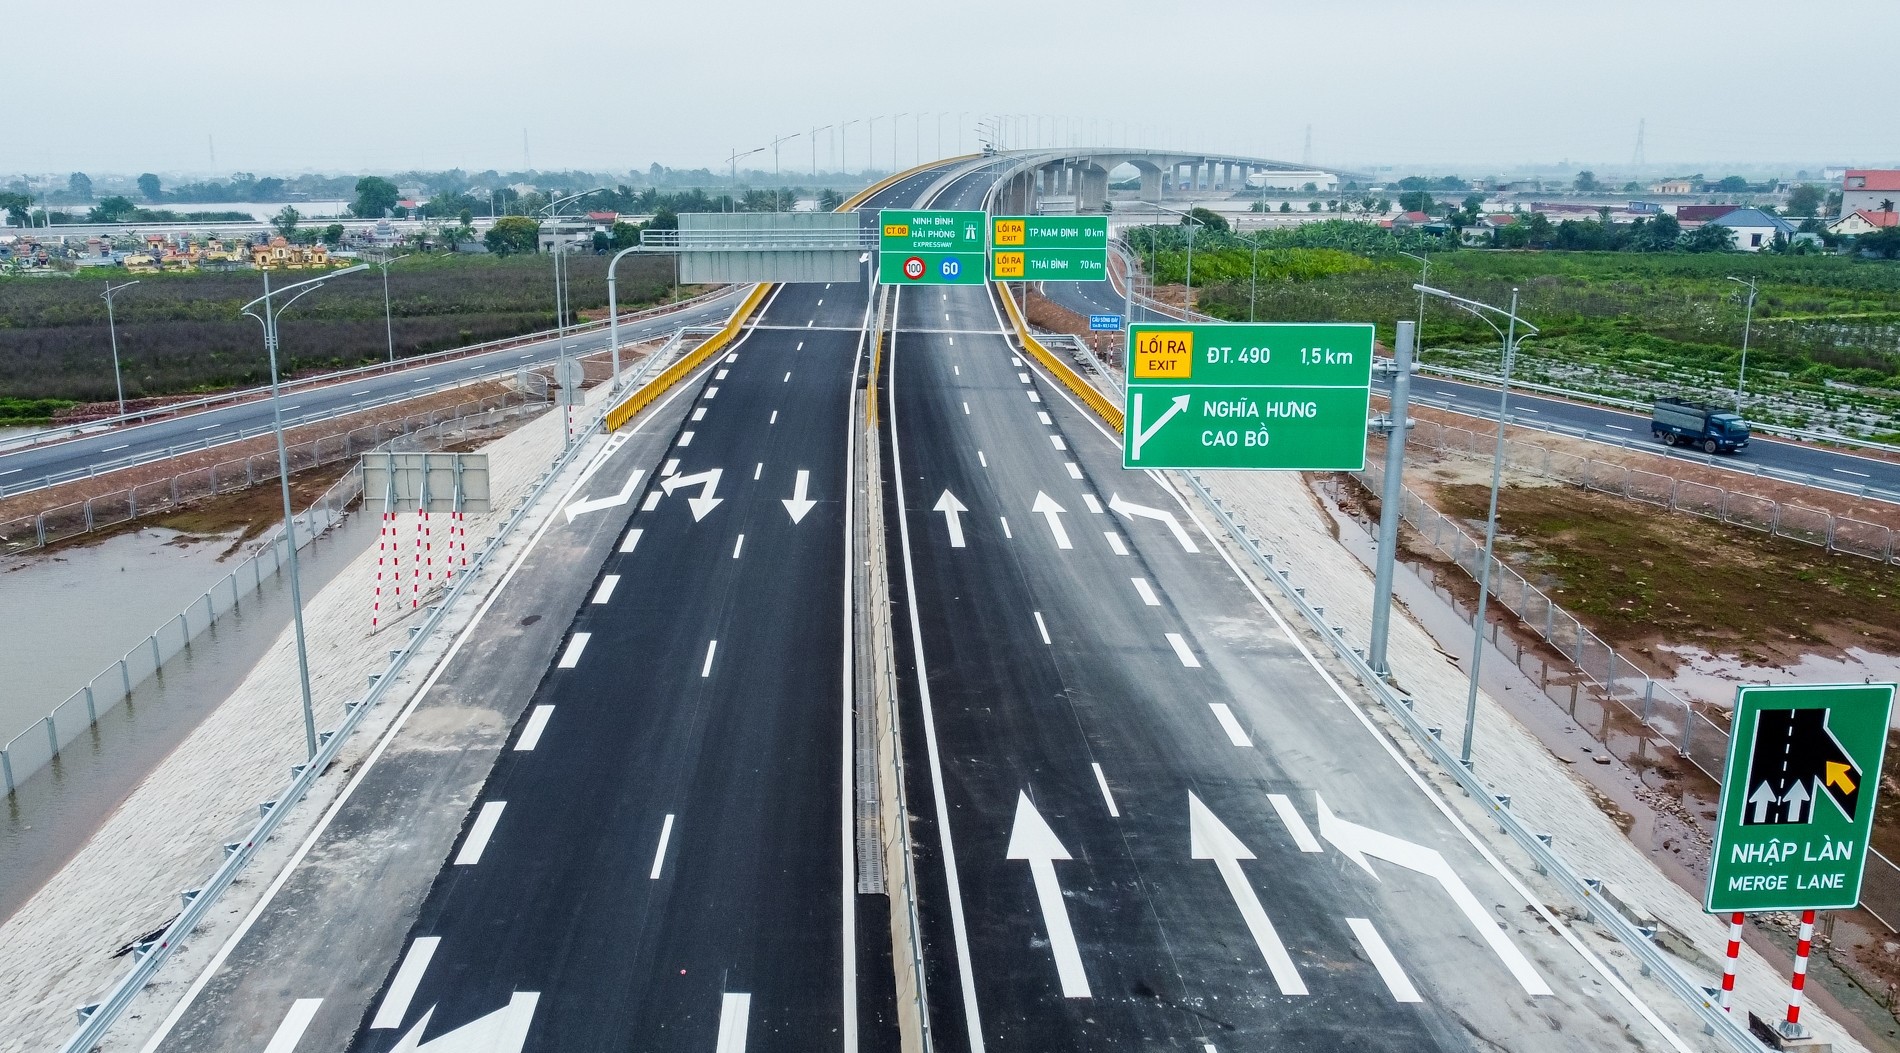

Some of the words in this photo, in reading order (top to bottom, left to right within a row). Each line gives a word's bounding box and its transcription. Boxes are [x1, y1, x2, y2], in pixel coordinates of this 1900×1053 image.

[934, 216, 954, 225] BÌNH
[998, 222, 1009, 232] LỐI
[912, 228, 925, 238] HẢI
[928, 229, 955, 238] PHÒNG
[1060, 228, 1078, 239] ĐỊNH
[1084, 228, 1091, 237] 10
[1092, 228, 1104, 237] km
[997, 255, 1009, 264] LỐI
[1031, 258, 1049, 269] THÁI
[1051, 258, 1068, 269] BÌNH
[1080, 260, 1089, 269] 70
[908, 263, 921, 273] 100
[942, 262, 958, 275] 60
[1140, 335, 1162, 354] LỐI
[1167, 340, 1187, 354] RA
[1300, 348, 1321, 366] 1,5
[1325, 348, 1353, 364] km
[1149, 360, 1177, 371] EXIT
[1204, 397, 1259, 418] NGHĨA
[1266, 400, 1317, 418] HƯNG
[1202, 430, 1238, 447] CAO
[1244, 422, 1269, 447] BỒ
[1731, 838, 1797, 867] NHẬP
[1803, 834, 1854, 862] LÀN
[1728, 875, 1788, 892] MERGE
[1796, 874, 1845, 890] LANE
